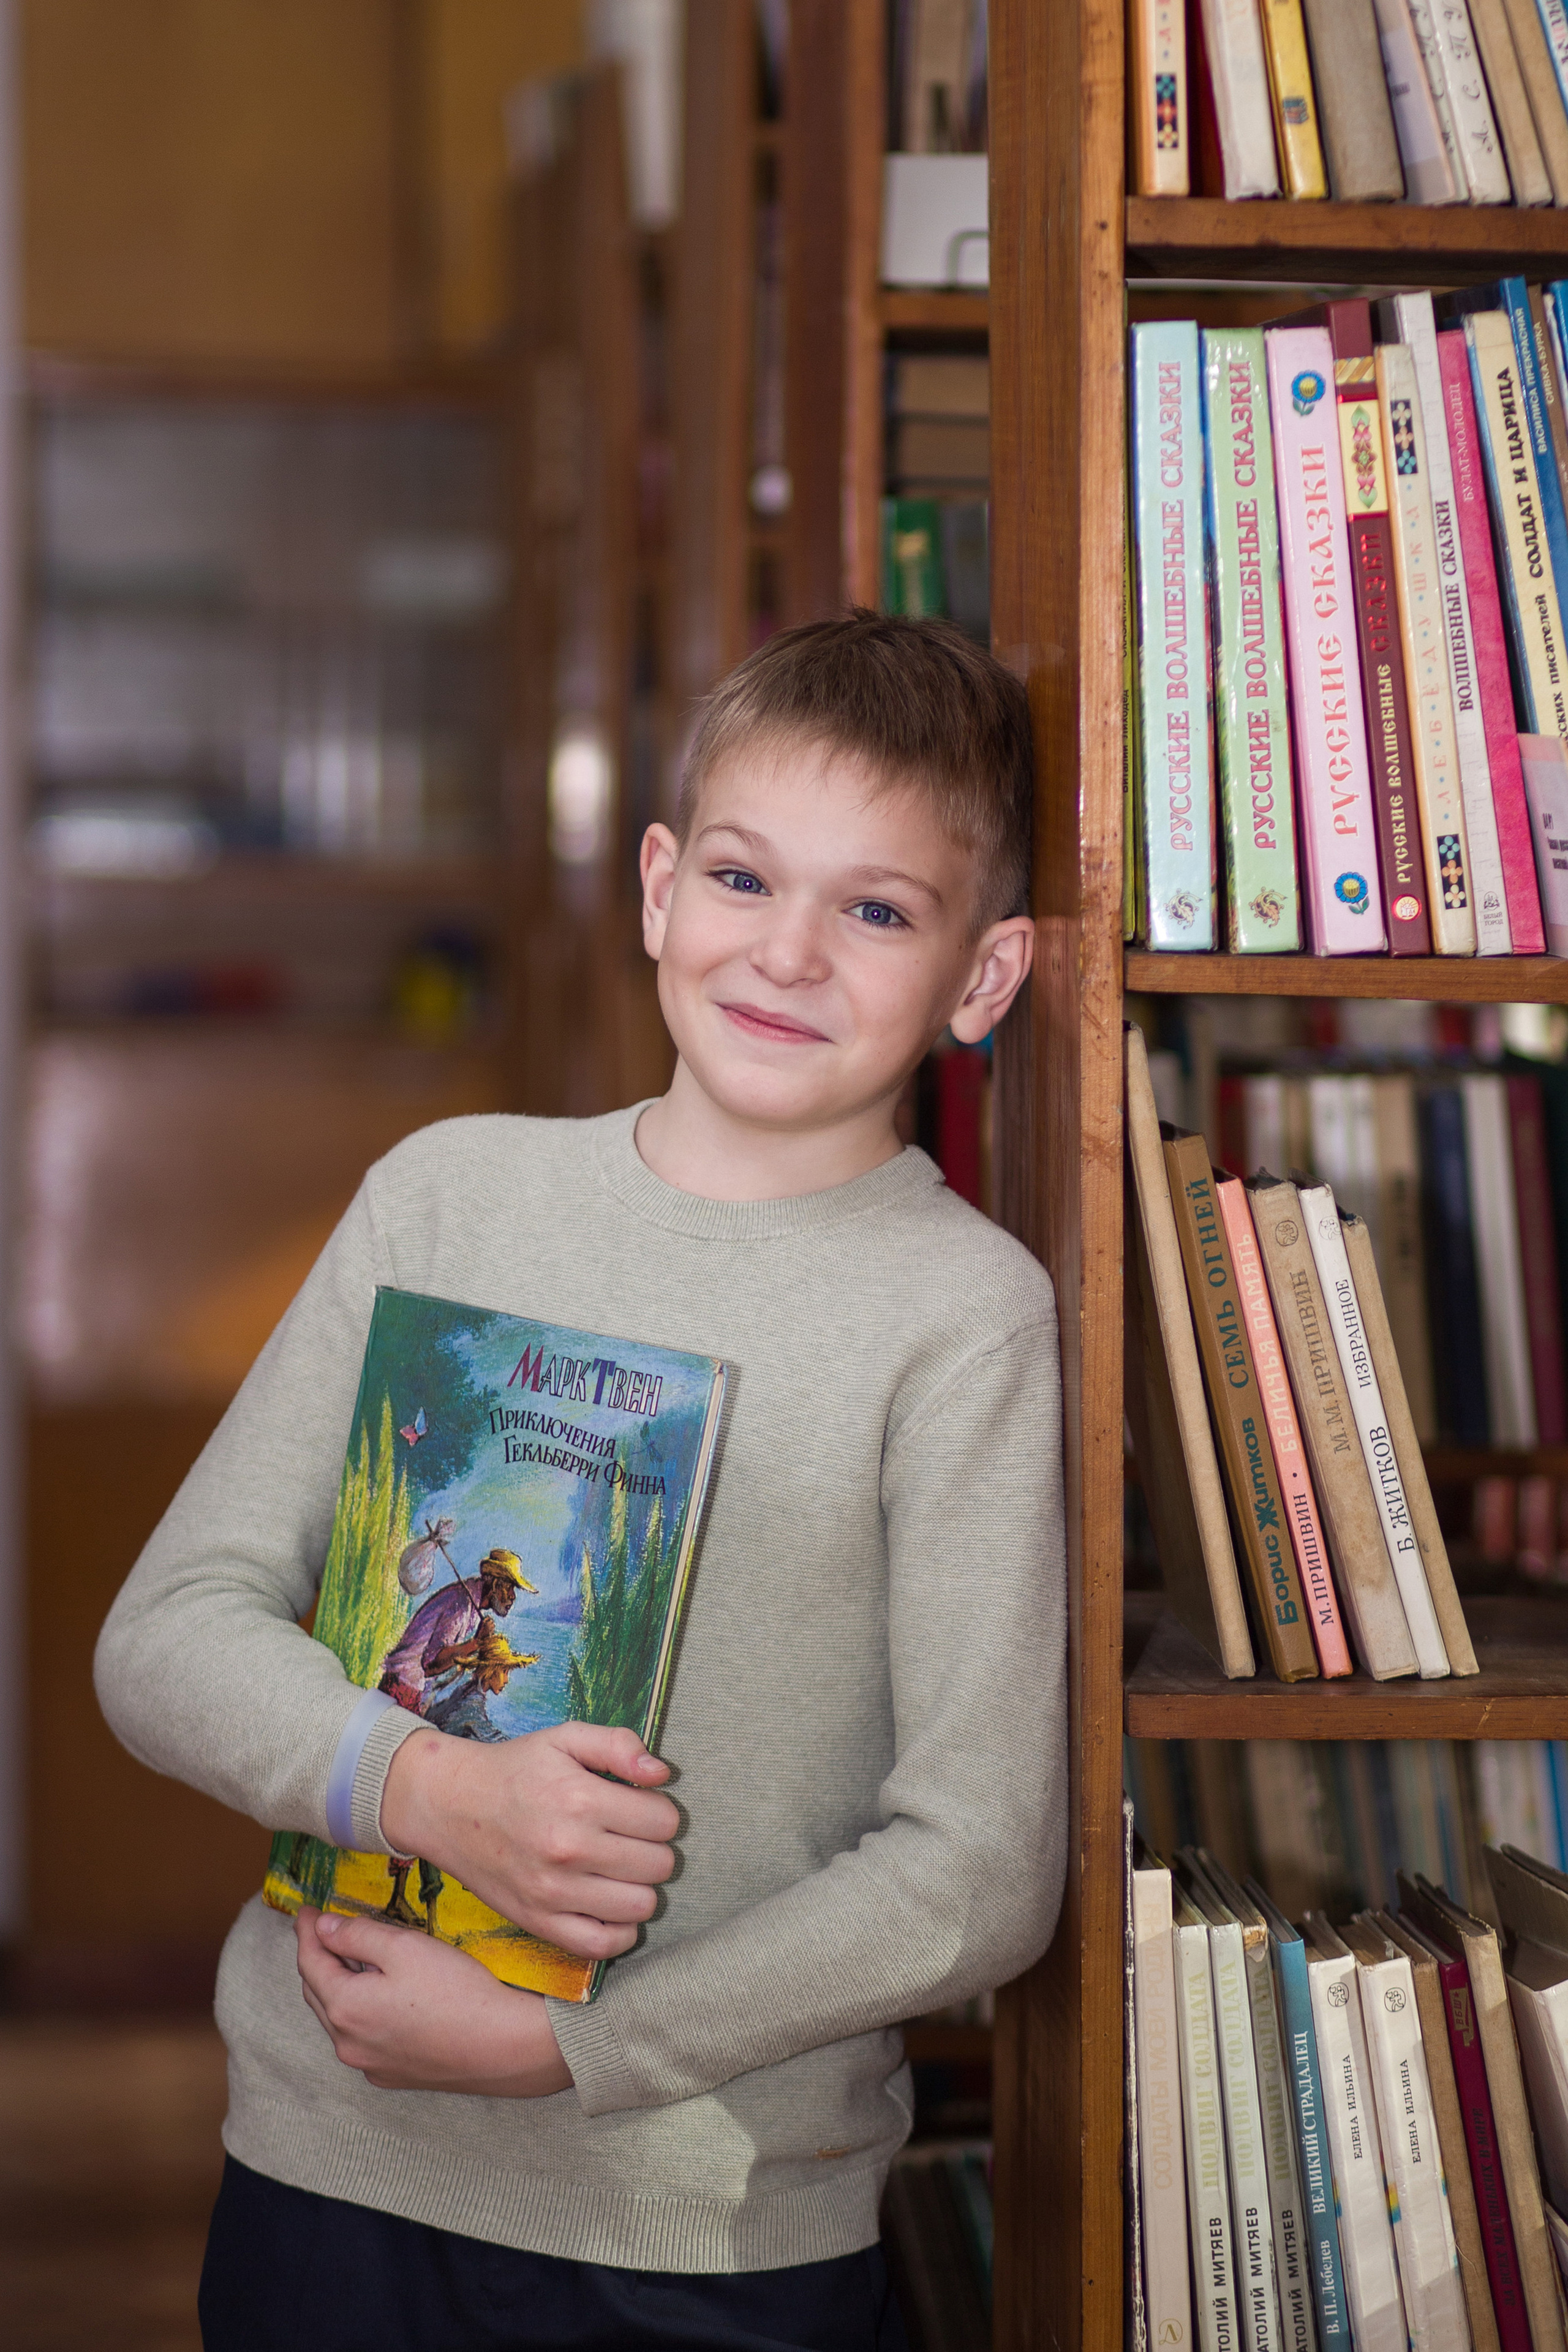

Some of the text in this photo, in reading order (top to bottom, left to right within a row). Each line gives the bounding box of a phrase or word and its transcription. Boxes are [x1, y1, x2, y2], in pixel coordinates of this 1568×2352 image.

[1497, 366, 1525, 461] ЦАРИЦА
[1515, 307, 1548, 454] ВАСИЛИСА ПРЕКРАСНАЯ
[1534, 322, 1555, 404] СИВКА-БУРКА
[1449, 382, 1474, 502] БУЛАТ-МОЛОДЕЦ
[1513, 466, 1529, 484] И
[1517, 493, 1544, 578] СОЛДАТ
[1159, 361, 1193, 850] РУССКИЕ ВОЛШЕБНЫЕ СКАЗКИ
[1229, 361, 1276, 849] РУССКИЕ ВОЛШЕБНЫЕ СКАЗКИ
[1301, 443, 1359, 837] РУССКИЕ СКАЗКИ
[1435, 499, 1474, 712] ВОЛШЕБНЫЕ СКАЗКИ
[1536, 593, 1560, 685] писателей
[1378, 663, 1402, 788] ВОЛШЕБНЫЕ
[1390, 794, 1411, 883] РУССКИЕ
[1288, 1269, 1336, 1396] ПРИШВИН
[1186, 1177, 1298, 1625] Борис Житков СЕМЬ ОГНЕЙ
[1242, 1234, 1334, 1626] М. ПРИШВИН БЕЛИЧЬЯ ПАМЯТЬ
[1335, 1278, 1415, 1553] Б. ЖИТКОВ ИЗБРАННОЕ
[1146, 1904, 1165, 1997] РОДИНЫ
[1188, 1972, 1219, 2188] ПОДВИГ СОЛДАТА
[1219, 1959, 1254, 2178] ПОДВИГ СОЛДАТА
[1253, 1965, 1291, 2180] ПОДВИГ СОЛДАТА
[1343, 2053, 1363, 2160] ЕЛЕНА ИЛЬИНА
[1400, 2059, 1422, 2164] ЕЛЕНА ИЛЬИНА
[1152, 2080, 1172, 2190] СОЛДАТЫ
[1294, 2030, 1340, 2334] В. П. Лебедев ВЕЛИКИЙ СТРАДАЛЕЦ
[1209, 2217, 1226, 2287] МИТЯЕВ
[1246, 2207, 1263, 2277] МИТЯЕВ
[1282, 2209, 1300, 2279] МИТЯЕВ
